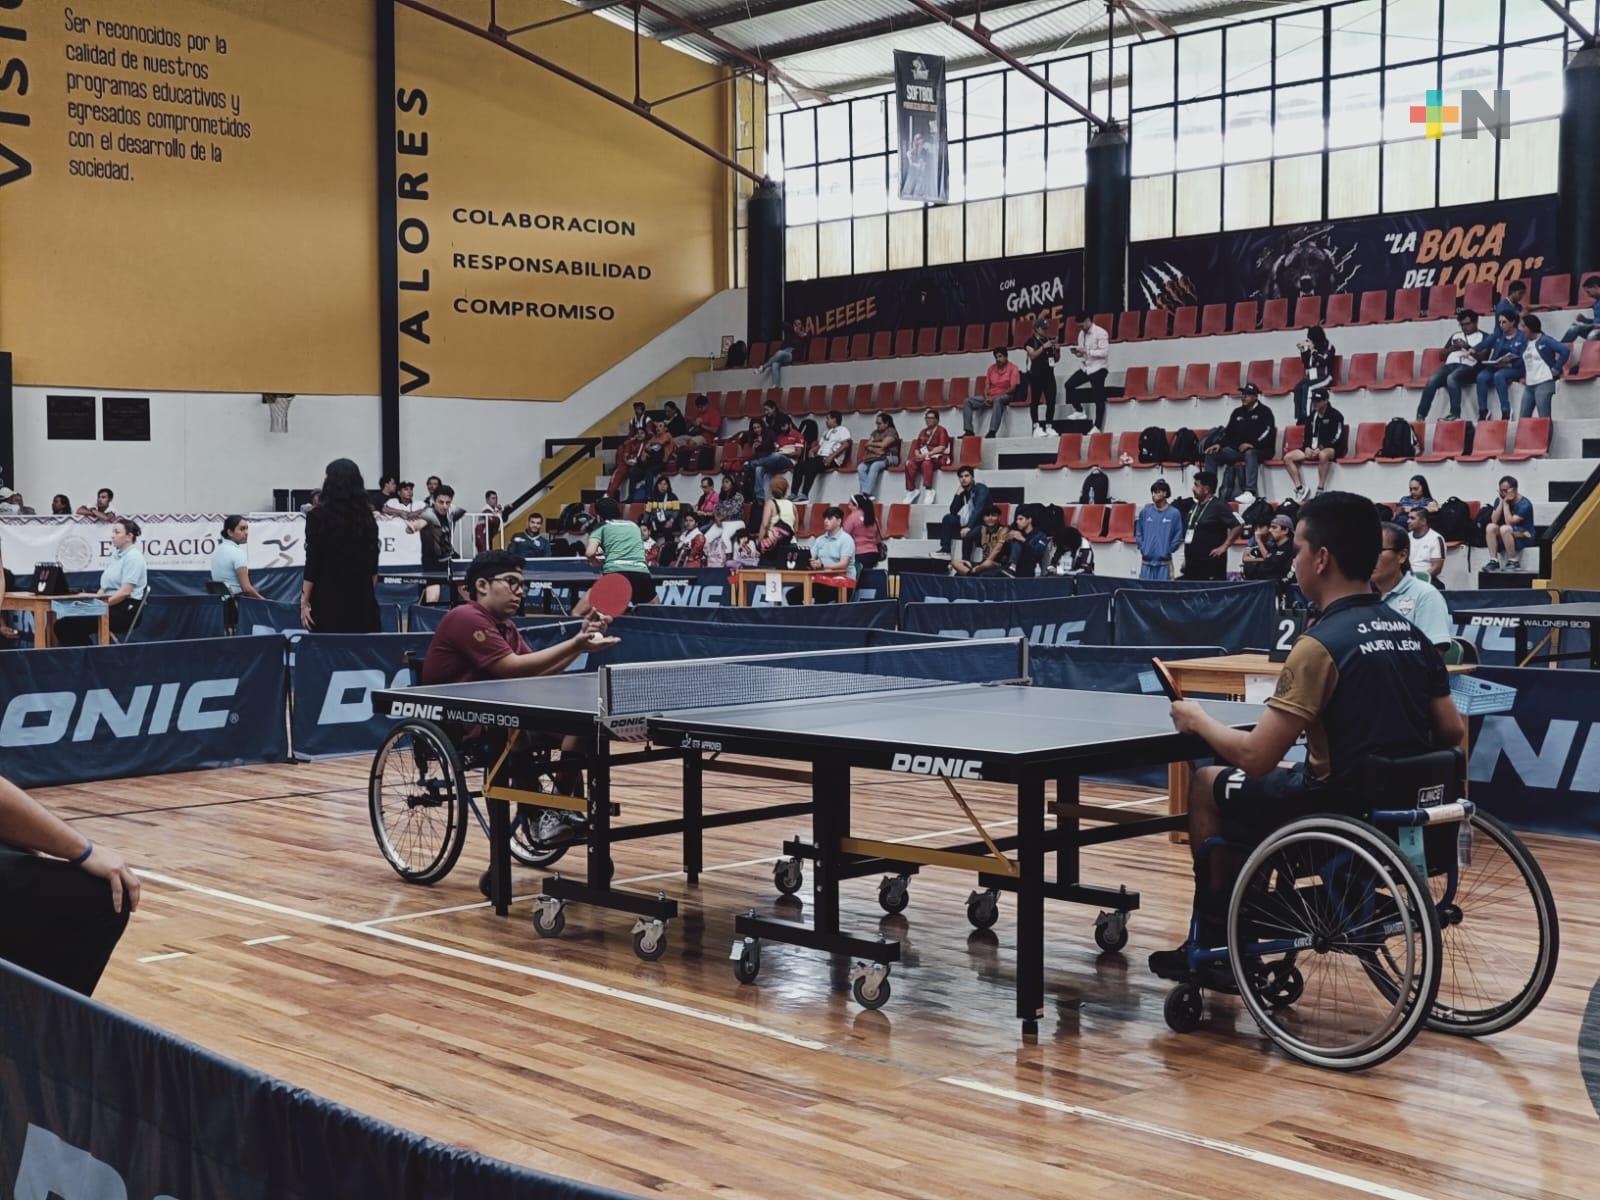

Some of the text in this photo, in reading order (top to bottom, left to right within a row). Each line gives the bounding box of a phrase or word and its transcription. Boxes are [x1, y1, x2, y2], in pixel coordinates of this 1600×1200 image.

[64, 7, 228, 54] Ser reconocidos por la
[66, 43, 209, 80] calidad de nuestros
[0, 0, 32, 188] VISI
[67, 71, 241, 116] programas educativos y
[67, 101, 251, 138] egresados comprometidos
[68, 130, 222, 162] con el desarrollo de la
[69, 158, 135, 181] sociedad.
[452, 207, 636, 236] COLABORACION
[397, 87, 431, 395] VALORES
[1416, 222, 1506, 264] BOCA
[452, 252, 652, 280] RESPONSABILIDAD
[1403, 268, 1436, 289] DEL
[999, 279, 1016, 291] CON
[1007, 276, 1064, 312] GARRA
[453, 297, 615, 321] COMPROMISO
[1276, 619, 1295, 650] 2
[1470, 616, 1590, 629] DONIC WALDNER 909
[1360, 640, 1395, 655] NUEVO
[390, 701, 520, 727] DONIC WALDNER 909
[610, 716, 646, 728] DONIC
[891, 753, 983, 779] DONIC
